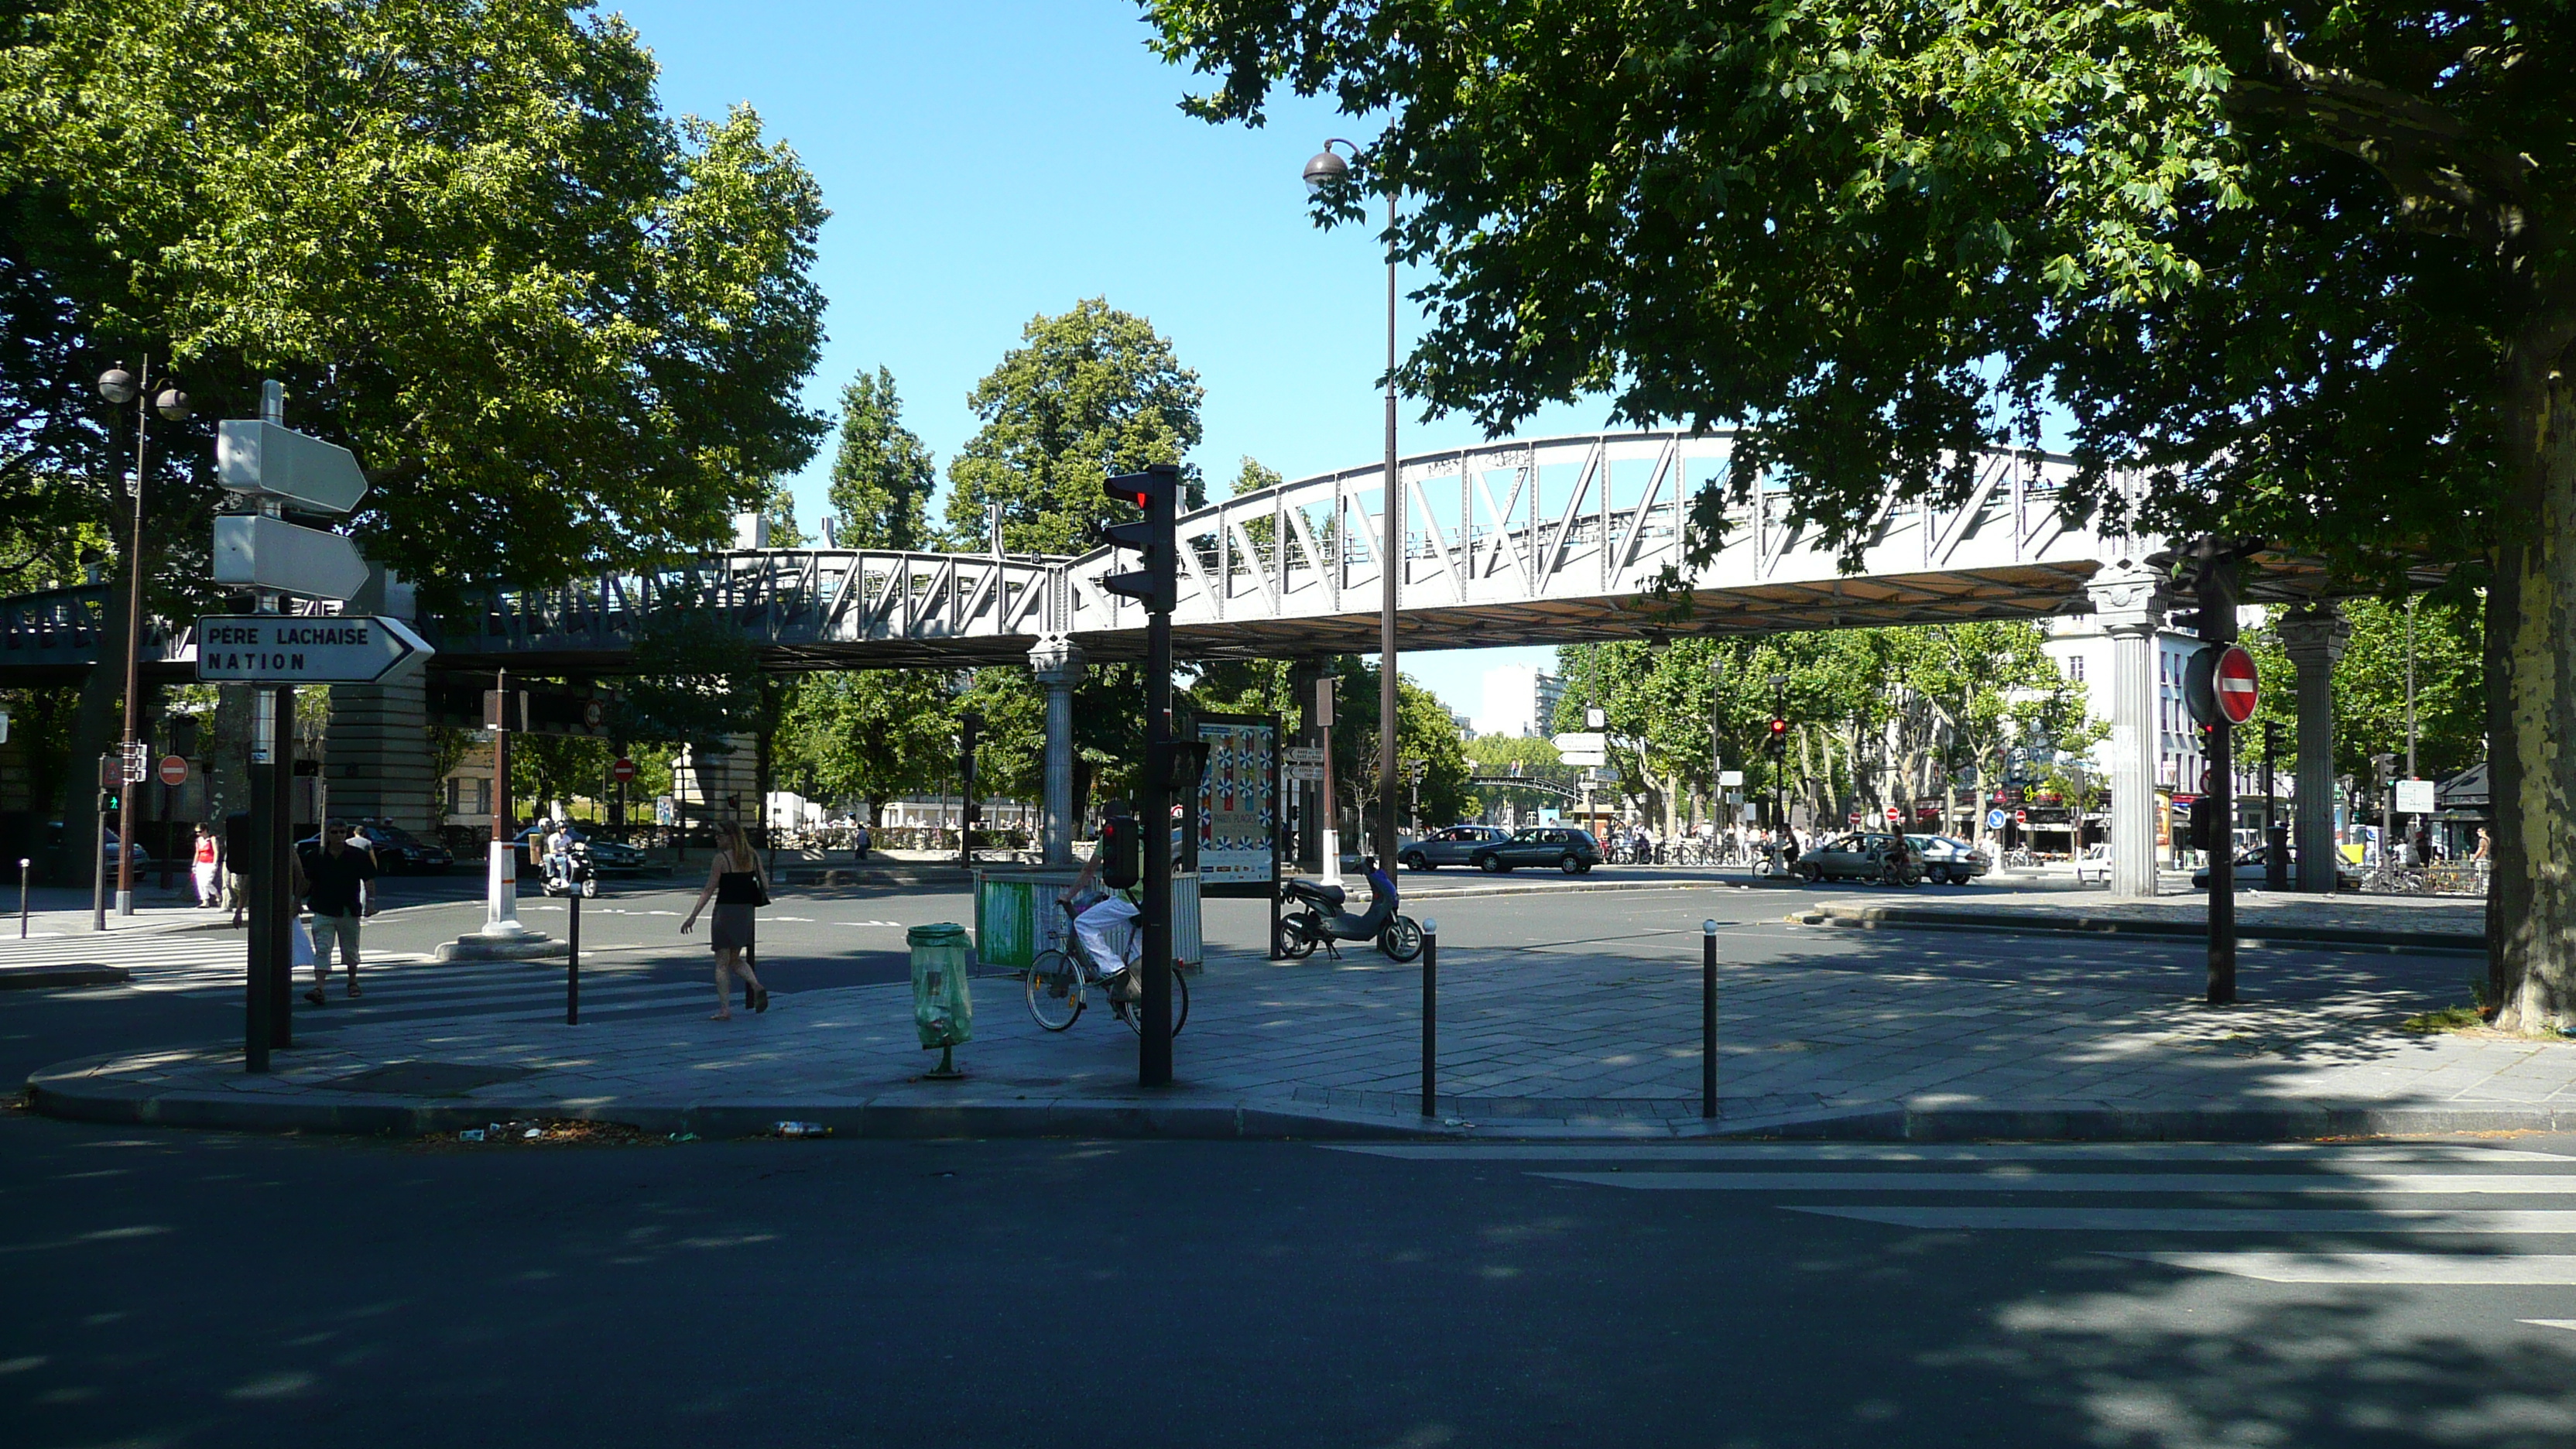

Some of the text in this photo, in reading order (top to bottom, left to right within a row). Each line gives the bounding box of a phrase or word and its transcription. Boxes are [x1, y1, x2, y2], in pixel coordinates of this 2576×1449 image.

[208, 625, 368, 645] PÈRE LACHAISE
[207, 653, 304, 670] NATION
